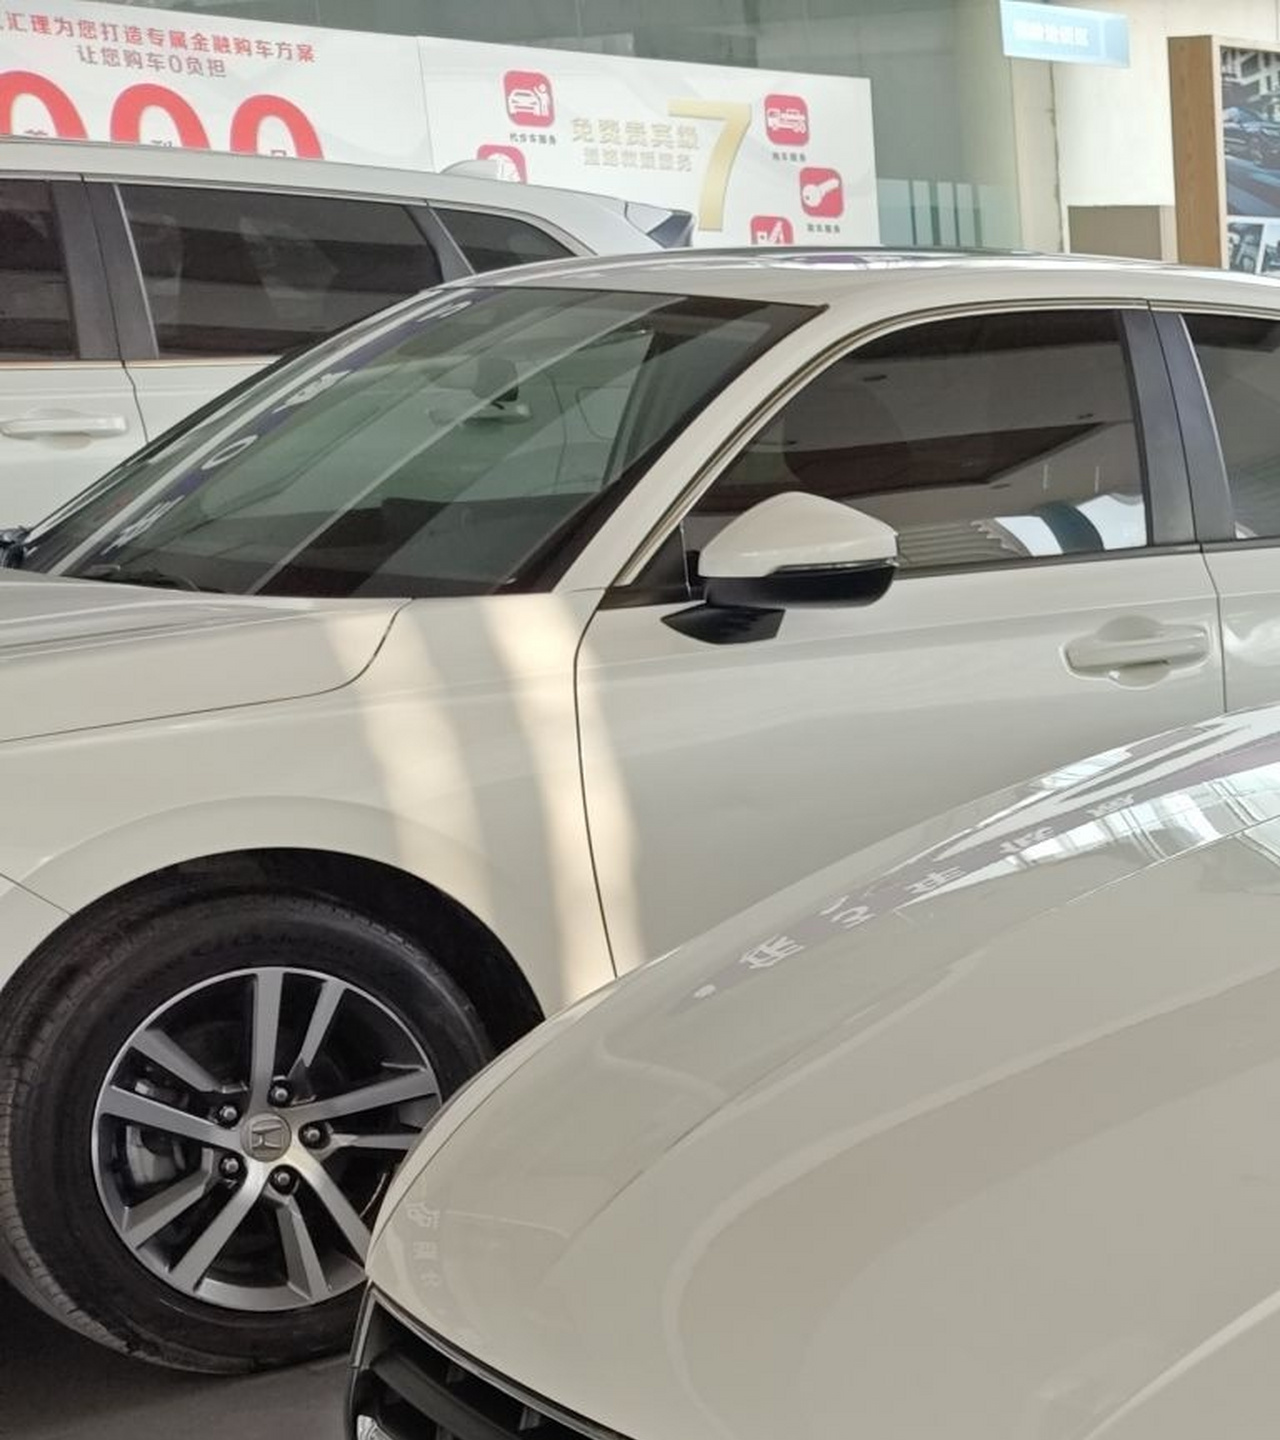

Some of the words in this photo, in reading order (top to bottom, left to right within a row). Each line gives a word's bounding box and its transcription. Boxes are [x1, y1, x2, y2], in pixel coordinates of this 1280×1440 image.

[0, 11, 316, 63] 汇理为您打造专属金融购车方案
[78, 45, 227, 78] 让您购车0负担
[667, 98, 752, 231] 7
